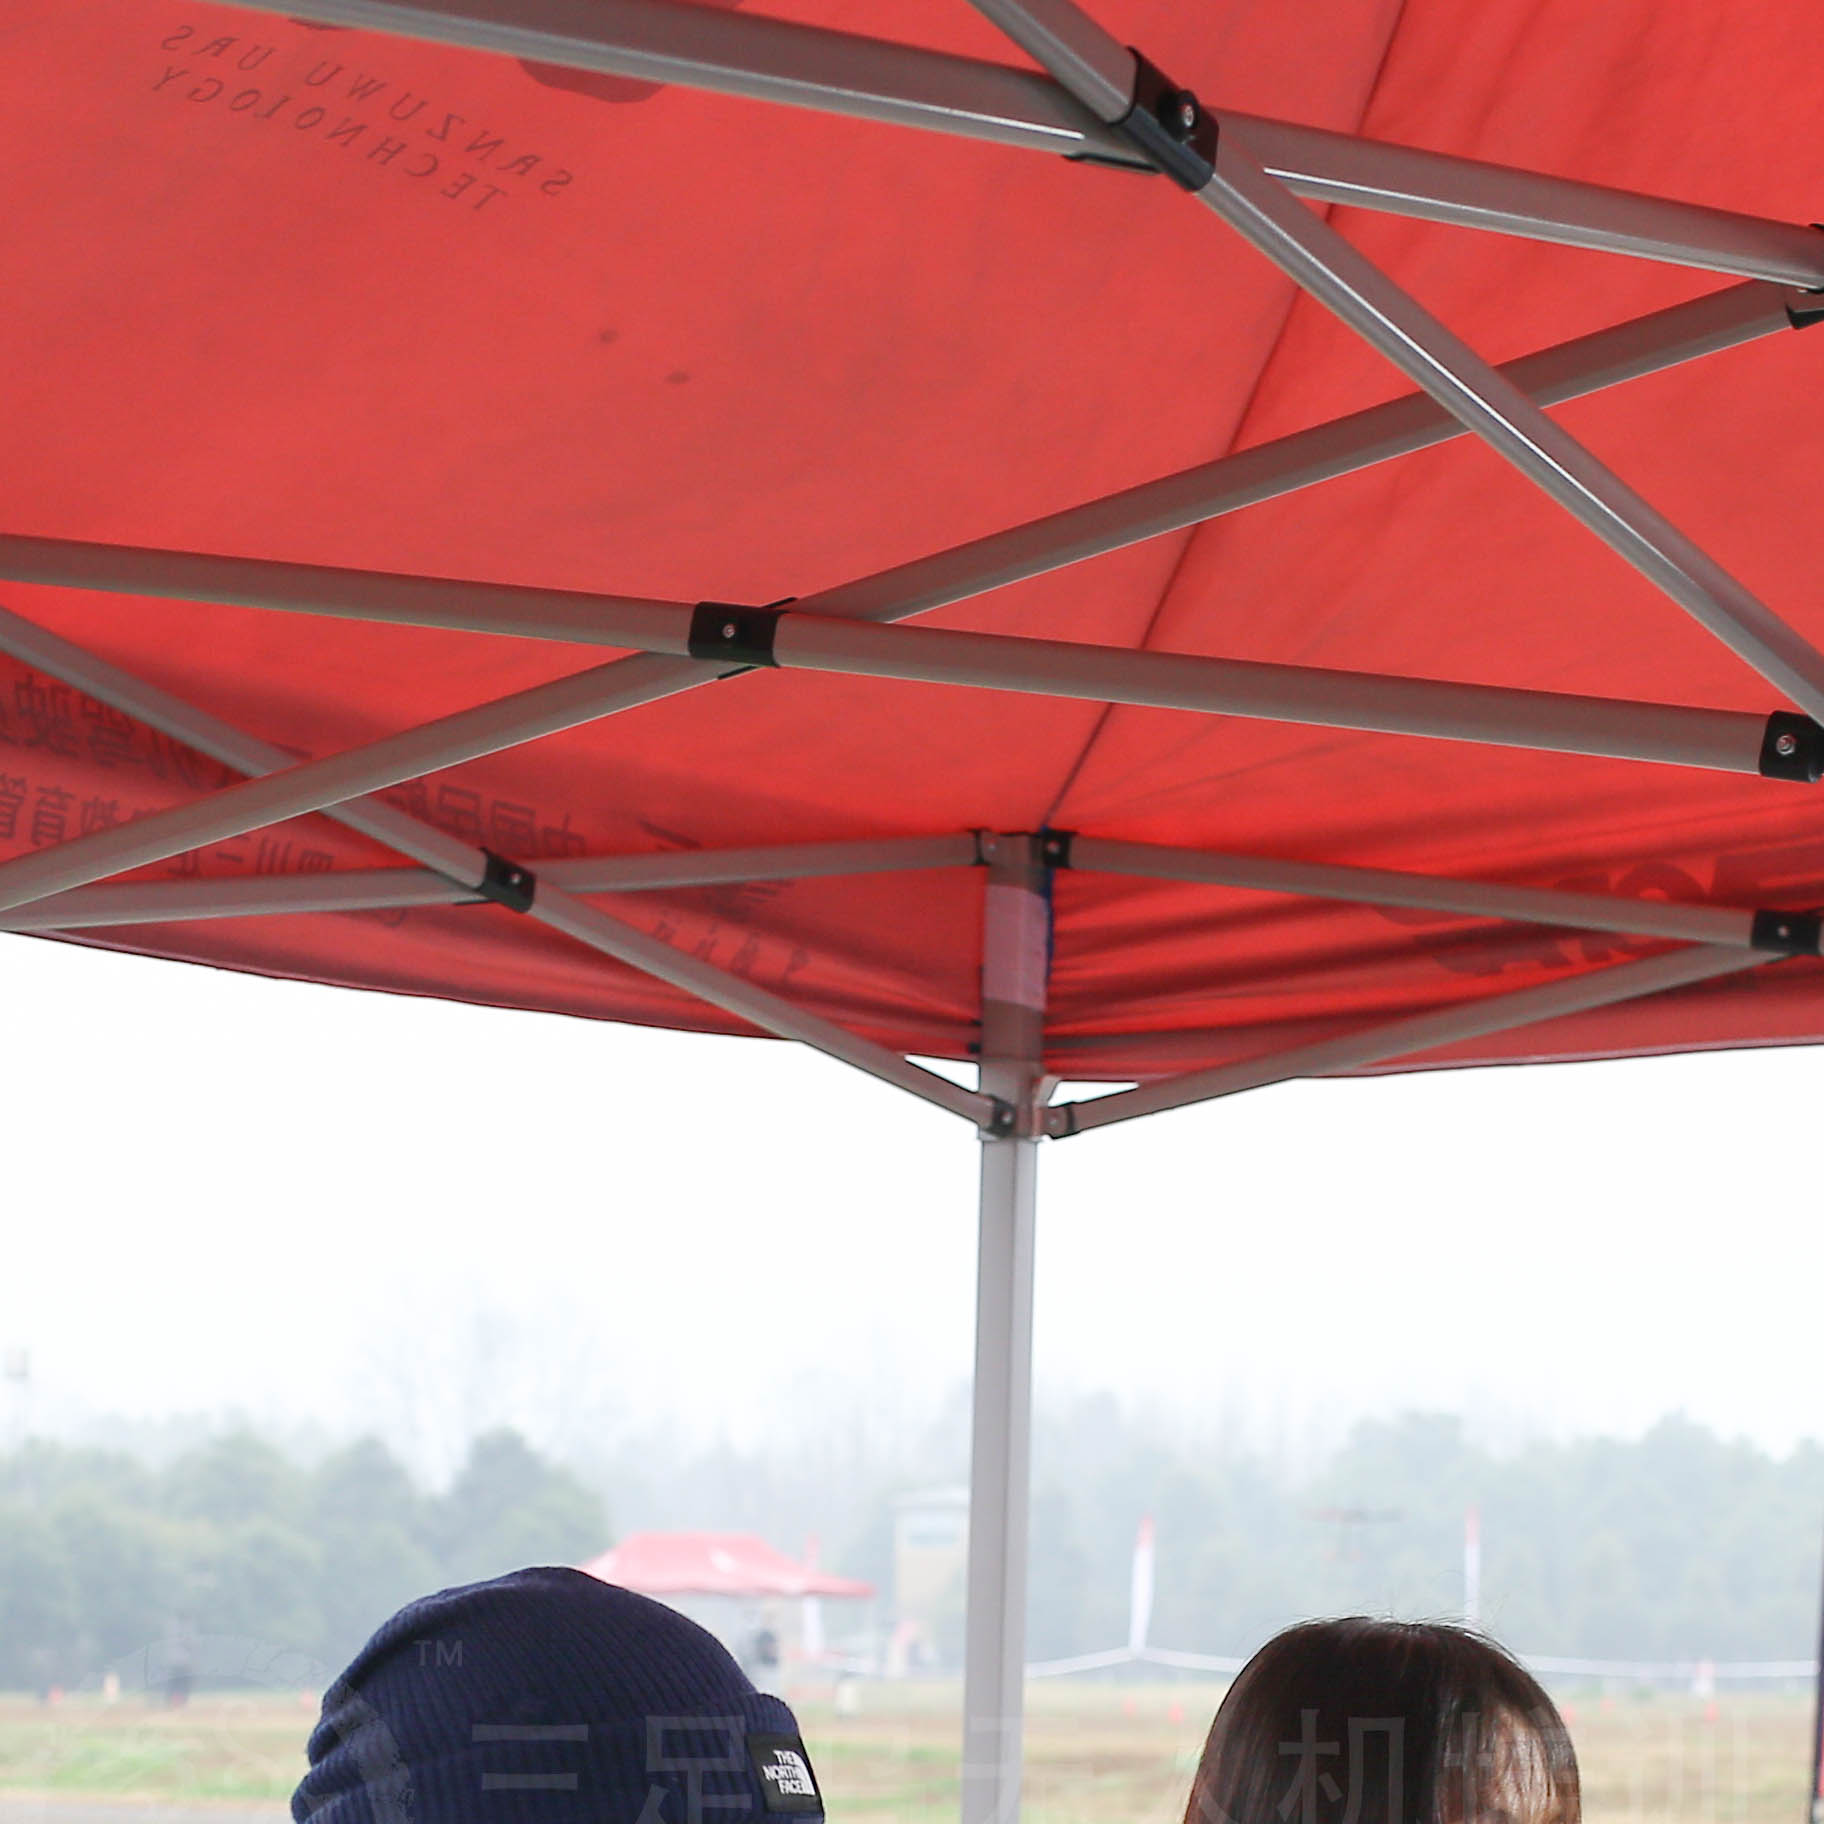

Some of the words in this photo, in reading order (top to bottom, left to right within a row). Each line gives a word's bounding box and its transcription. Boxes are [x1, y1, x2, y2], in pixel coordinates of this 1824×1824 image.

[773, 1750, 796, 1766] THE
[762, 1764, 803, 1781] NORTH
[777, 1780, 804, 1794] FACE
